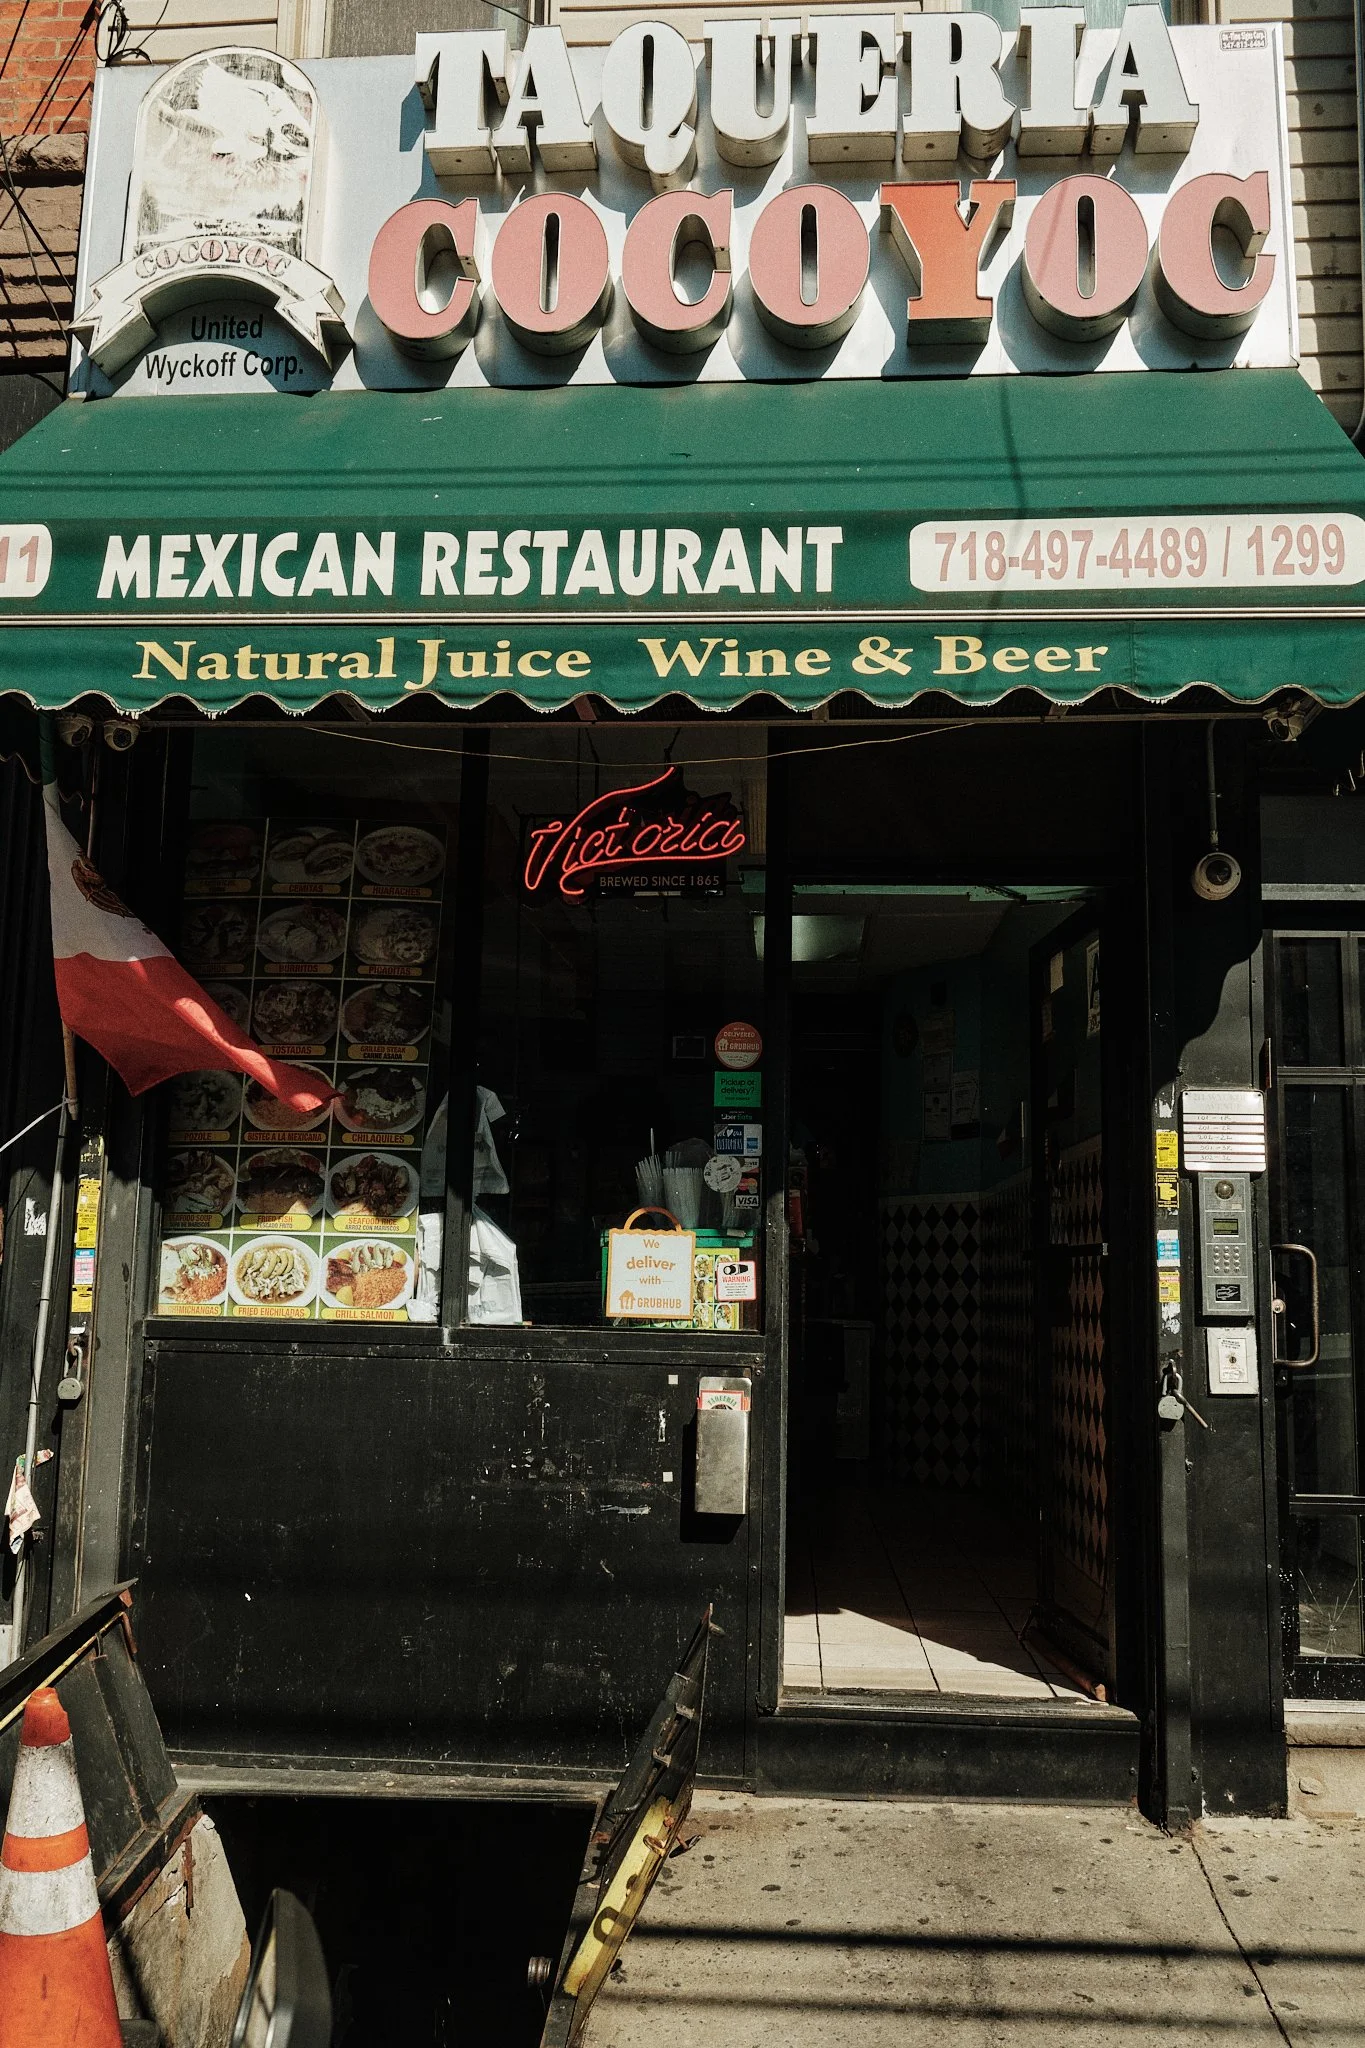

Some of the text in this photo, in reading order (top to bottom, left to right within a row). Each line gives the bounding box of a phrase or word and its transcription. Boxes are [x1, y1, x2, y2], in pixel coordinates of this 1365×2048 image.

[415, 3, 1199, 175] TAQUERIA
[135, 239, 291, 278] COCOYOC
[368, 171, 1276, 345] COCOYOC
[191, 314, 263, 341] United
[145, 350, 304, 385] Wyckoff Corp.
[934, 523, 1346, 582] 718-497-4489 / 1299
[97, 526, 843, 598] MEXICAN RESTAURANT
[131, 635, 1108, 690] Natural Juice Wine & Beer
[524, 766, 746, 895] Victoria
[600, 875, 720, 887] BREWED SINCE 1865
[289, 884, 324, 893] CEMITAS
[373, 887, 421, 896] HUARACHES
[279, 964, 318, 973] BURRITOS
[272, 1046, 312, 1054] TOSTADAS
[730, 1042, 760, 1050] GRUBHUB
[721, 1078, 746, 1086] Pickup
[721, 1087, 755, 1095] delivery?
[184, 1132, 212, 1141] POZOLE
[247, 1132, 271, 1141] BISTEC
[278, 1133, 287, 1141] LA
[287, 1133, 322, 1142] MEXICANA
[351, 1135, 404, 1143] CHILAQUILES
[738, 1197, 757, 1205] VISA
[348, 1217, 397, 1226] SEAFOOD RICE
[643, 1239, 660, 1249] We
[626, 1256, 676, 1271] deliver
[639, 1275, 662, 1285] with
[722, 1275, 751, 1283] WARNING
[637, 1297, 682, 1309] GRUBHUB
[238, 1306, 305, 1317] FRIED ENCHILADAS
[335, 1309, 395, 1320] GRILL SALMON
